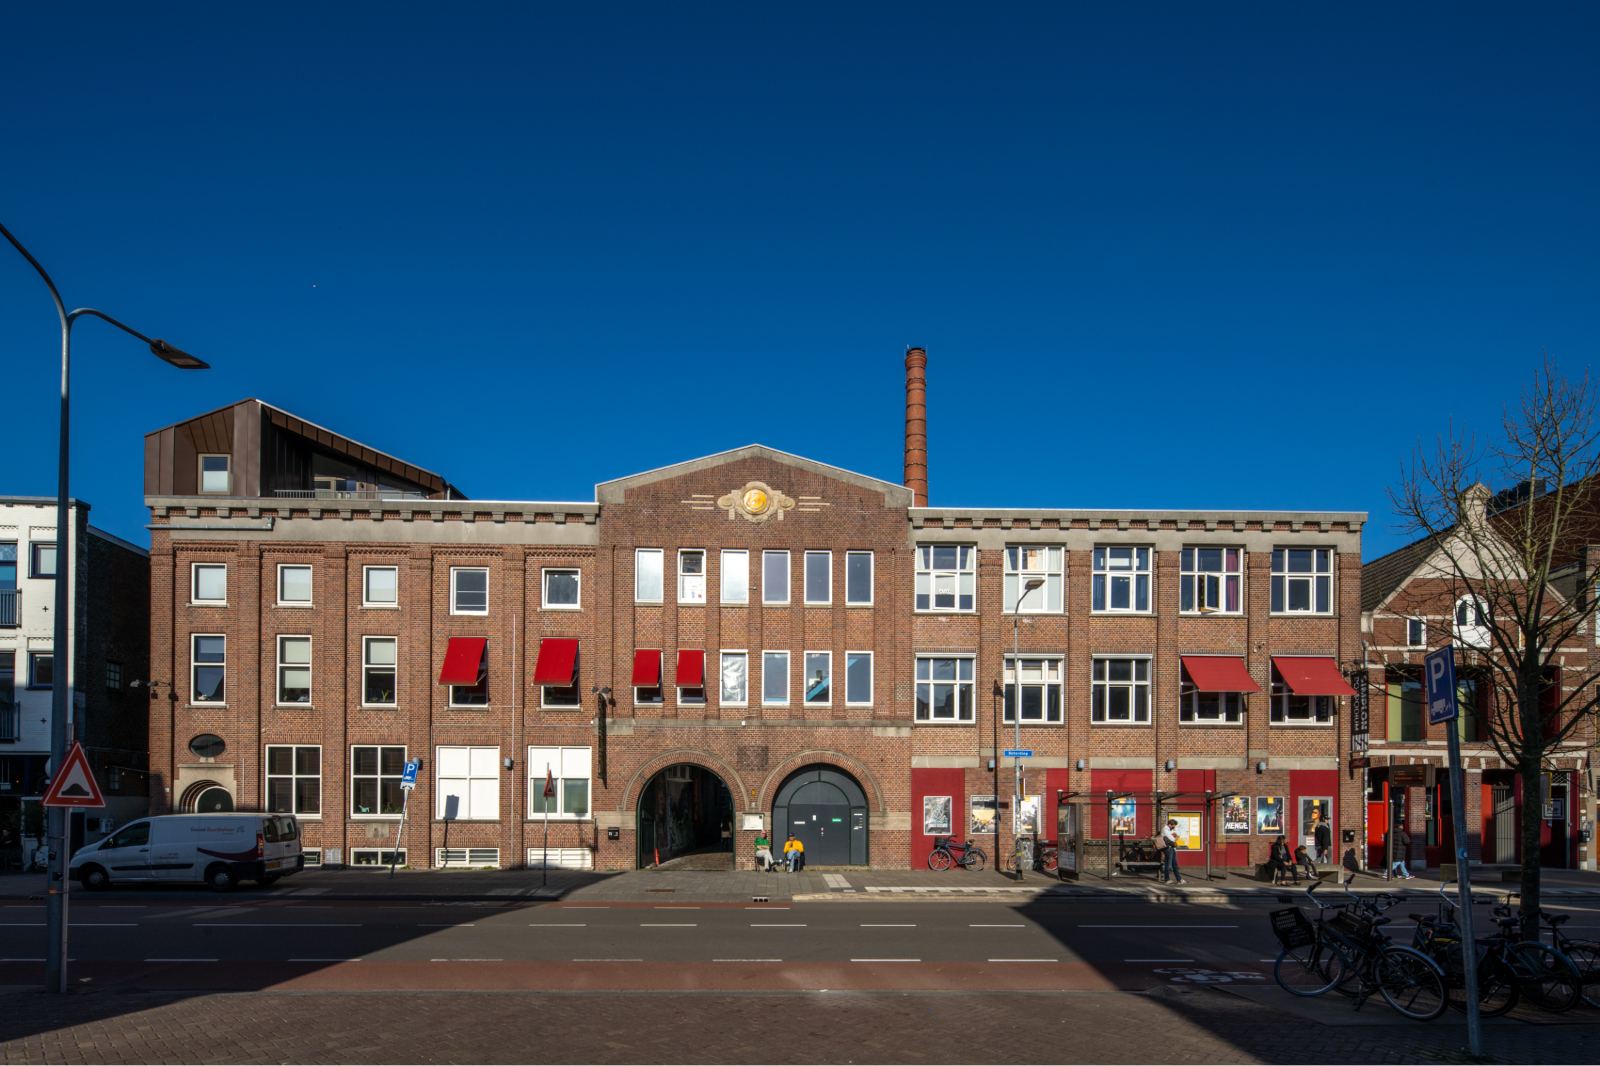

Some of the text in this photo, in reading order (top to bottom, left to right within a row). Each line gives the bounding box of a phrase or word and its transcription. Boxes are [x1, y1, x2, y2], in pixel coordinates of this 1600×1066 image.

[1430, 657, 1445, 694] P
[1360, 675, 1368, 730] SIMPLON
[406, 763, 415, 774] P
